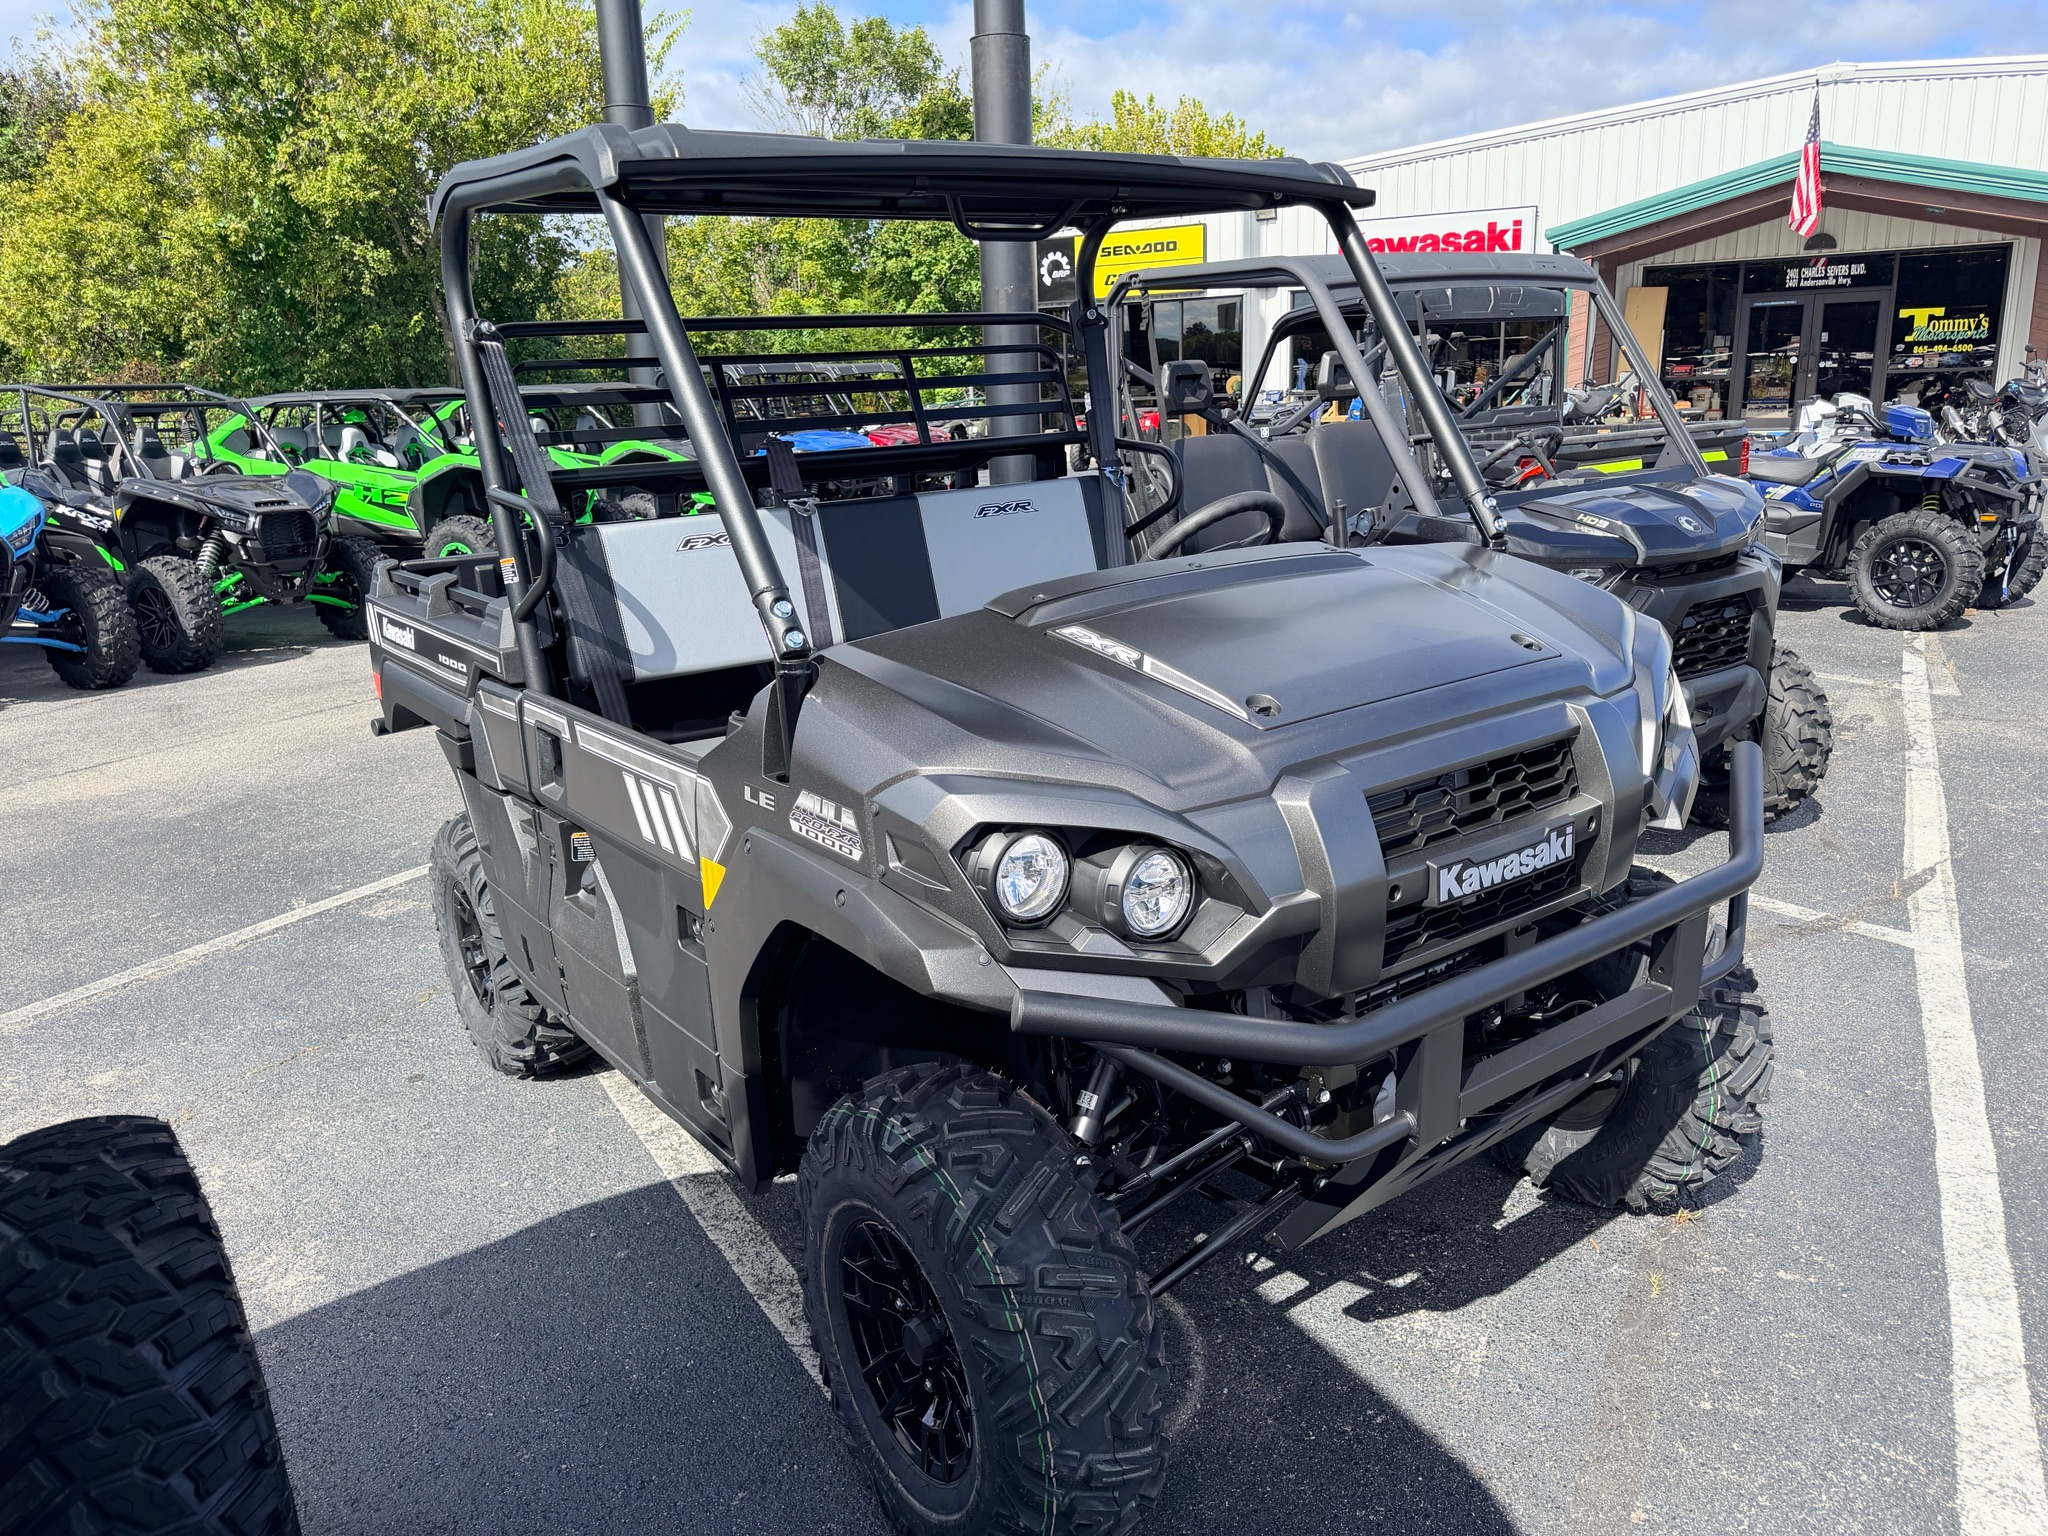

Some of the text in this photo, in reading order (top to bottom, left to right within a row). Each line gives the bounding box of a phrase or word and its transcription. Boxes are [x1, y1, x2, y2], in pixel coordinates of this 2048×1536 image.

[1338, 219, 1523, 254] awasaki
[1051, 269, 1071, 279] BRP
[1785, 279, 1799, 288] 2401
[1800, 277, 1836, 288] Andersonville
[1786, 268, 1799, 280] 2401
[1801, 266, 1826, 279] CHARLES
[1851, 263, 1867, 276] BLVD.
[1899, 307, 1990, 342] Tommy's
[1913, 325, 1989, 344] Motorsports
[1913, 343, 1974, 354] 865-494-6500
[56, 504, 113, 528] KRX4
[974, 499, 1039, 519] FXR
[1576, 513, 1610, 529] HD9
[676, 531, 731, 552] FX
[382, 616, 416, 650] Kawasaki
[1054, 625, 1141, 668] FXR
[438, 653, 468, 673] 1000
[744, 785, 776, 812] LE
[793, 790, 859, 836] MULE
[789, 810, 863, 851] PRO-FXR
[797, 824, 854, 857] 1000
[1439, 825, 1574, 903] Kawasaki
